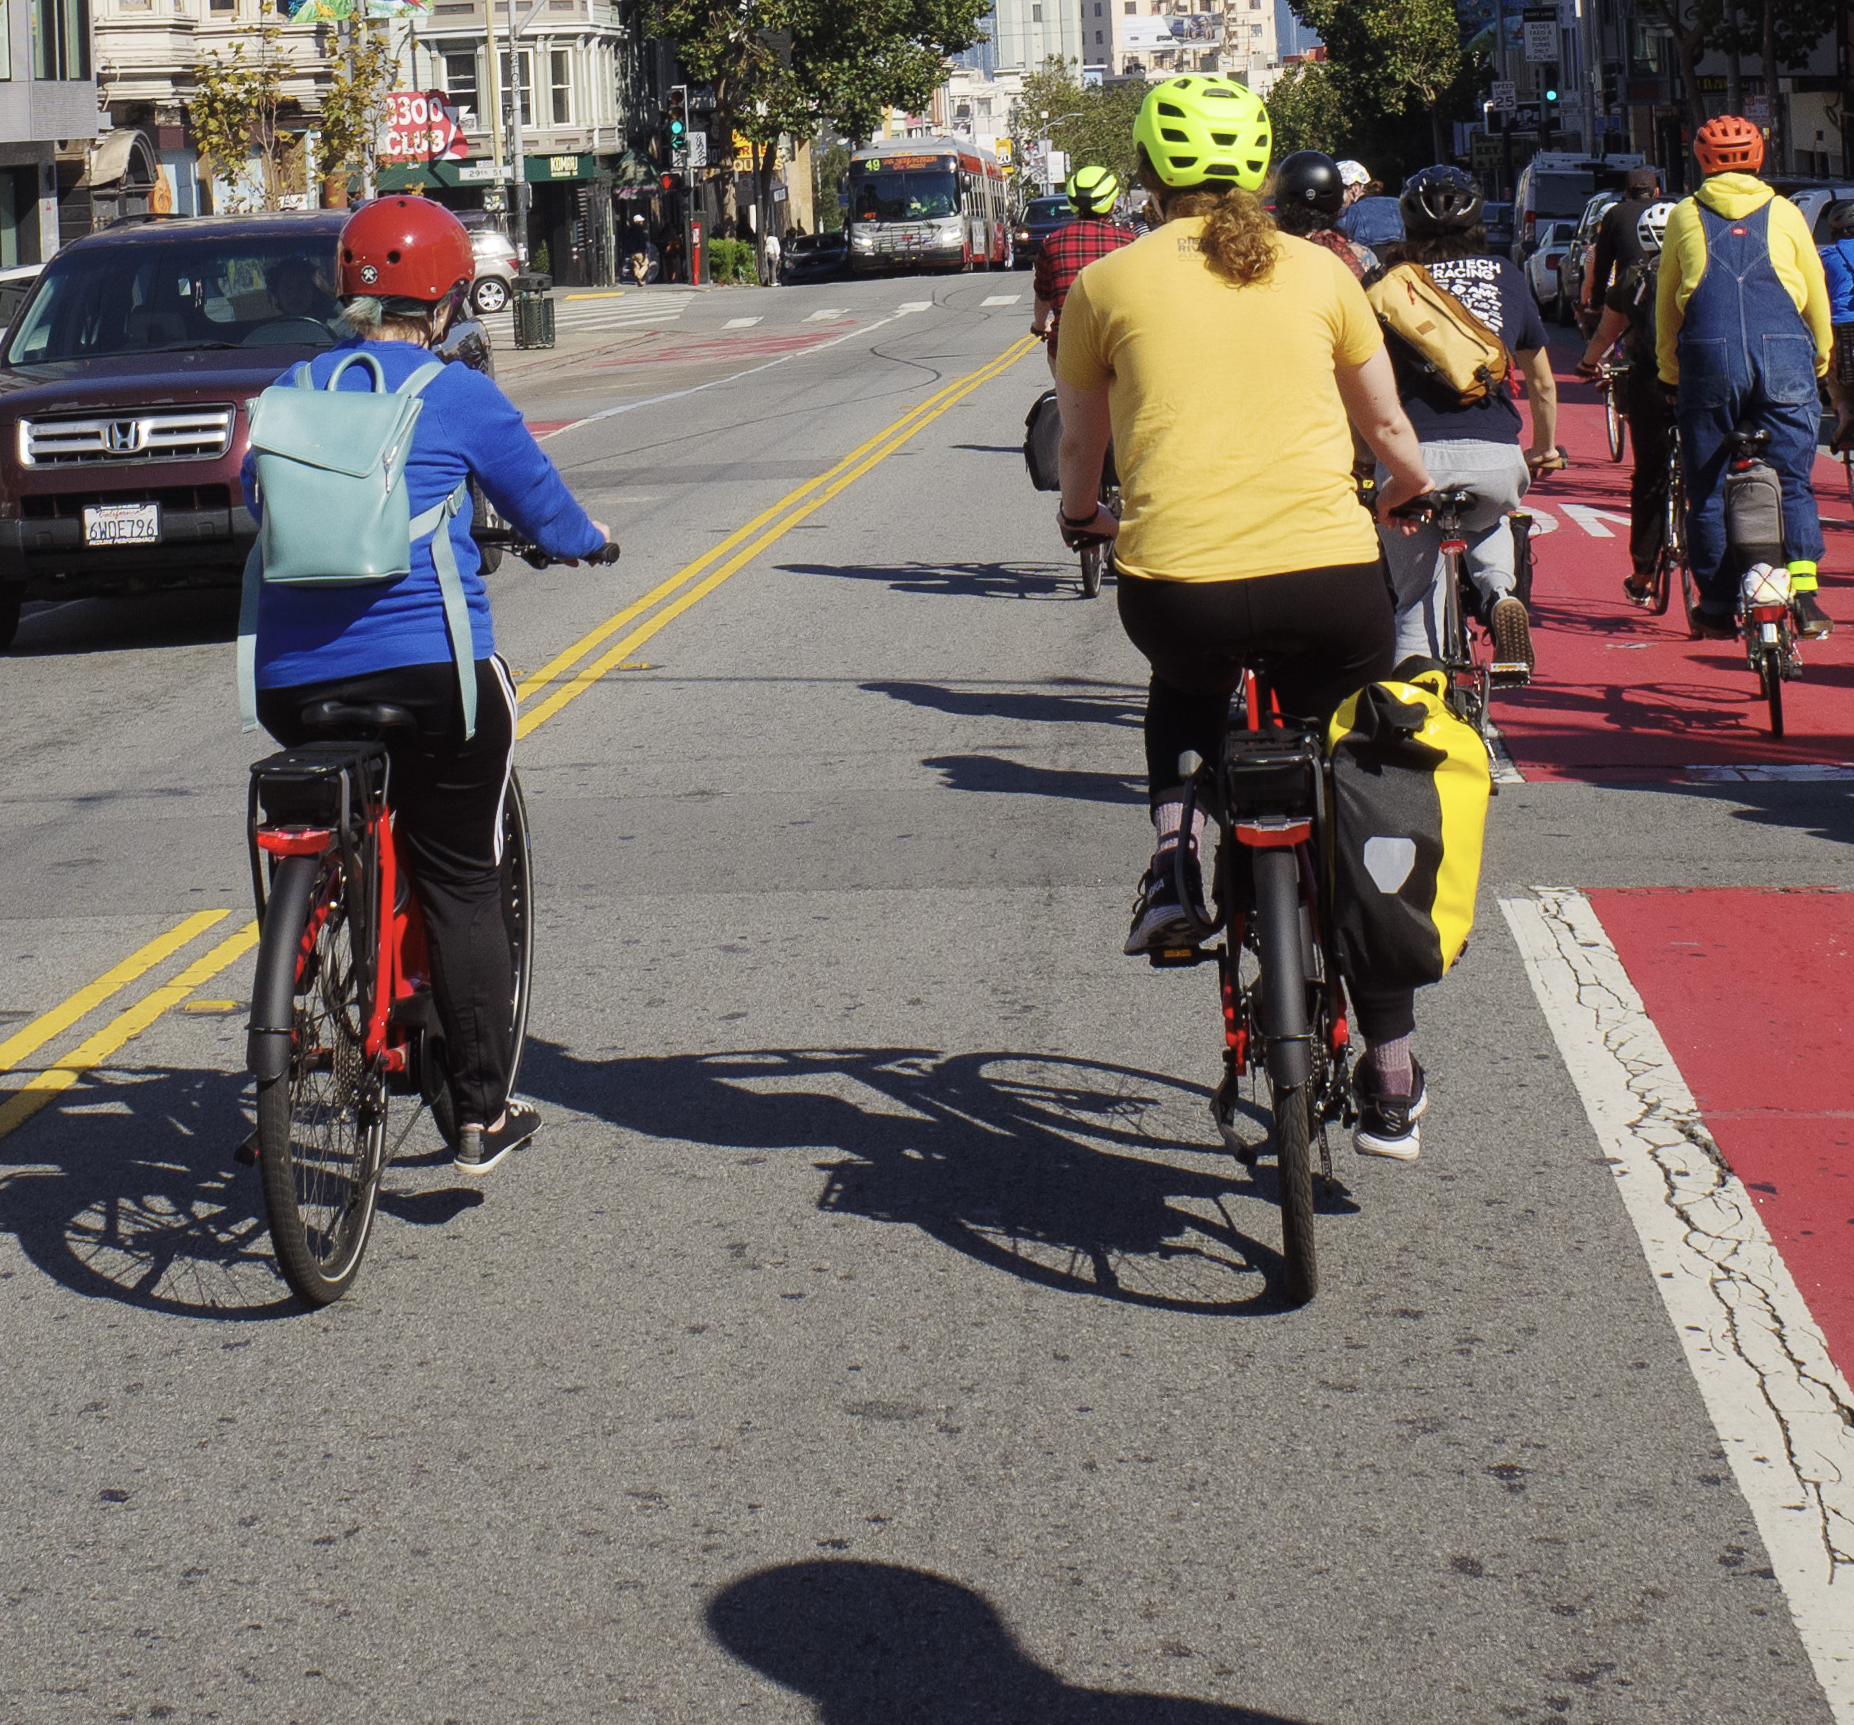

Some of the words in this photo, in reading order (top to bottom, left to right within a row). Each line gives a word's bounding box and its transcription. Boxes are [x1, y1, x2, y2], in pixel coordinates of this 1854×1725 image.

[1495, 96, 1515, 108] 25
[385, 129, 445, 156] CLUB
[865, 158, 881, 172] 49
[997, 153, 1012, 165] 20
